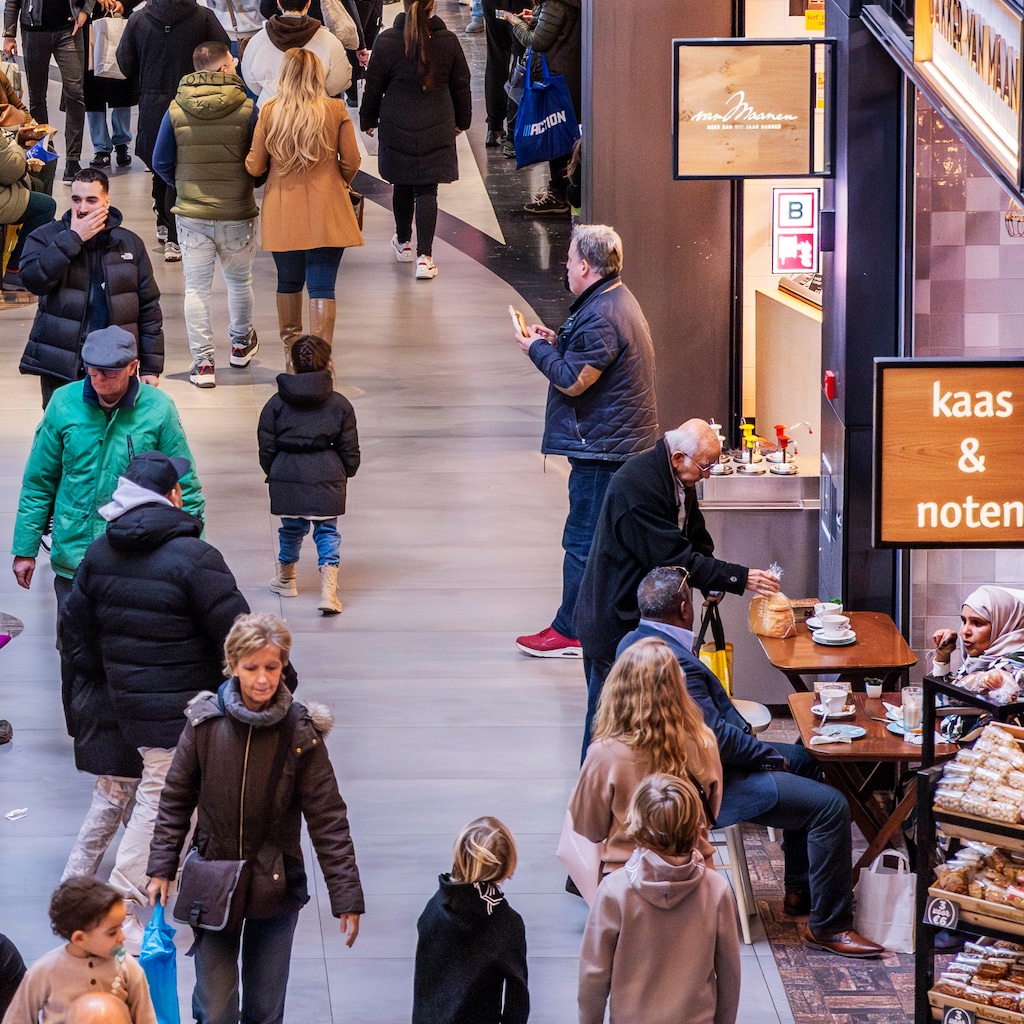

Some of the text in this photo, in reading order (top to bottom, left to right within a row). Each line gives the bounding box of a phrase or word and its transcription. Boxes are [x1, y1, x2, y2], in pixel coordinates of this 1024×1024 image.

[722, 90, 798, 123] Maanen
[530, 110, 567, 136] ACTION
[788, 201, 804, 220] B
[932, 380, 1014, 418] kaas
[957, 437, 986, 473] &
[917, 495, 1024, 528] noten
[938, 900, 947, 910] 3
[932, 915, 948, 927] €6
[955, 1010, 963, 1020] 3
